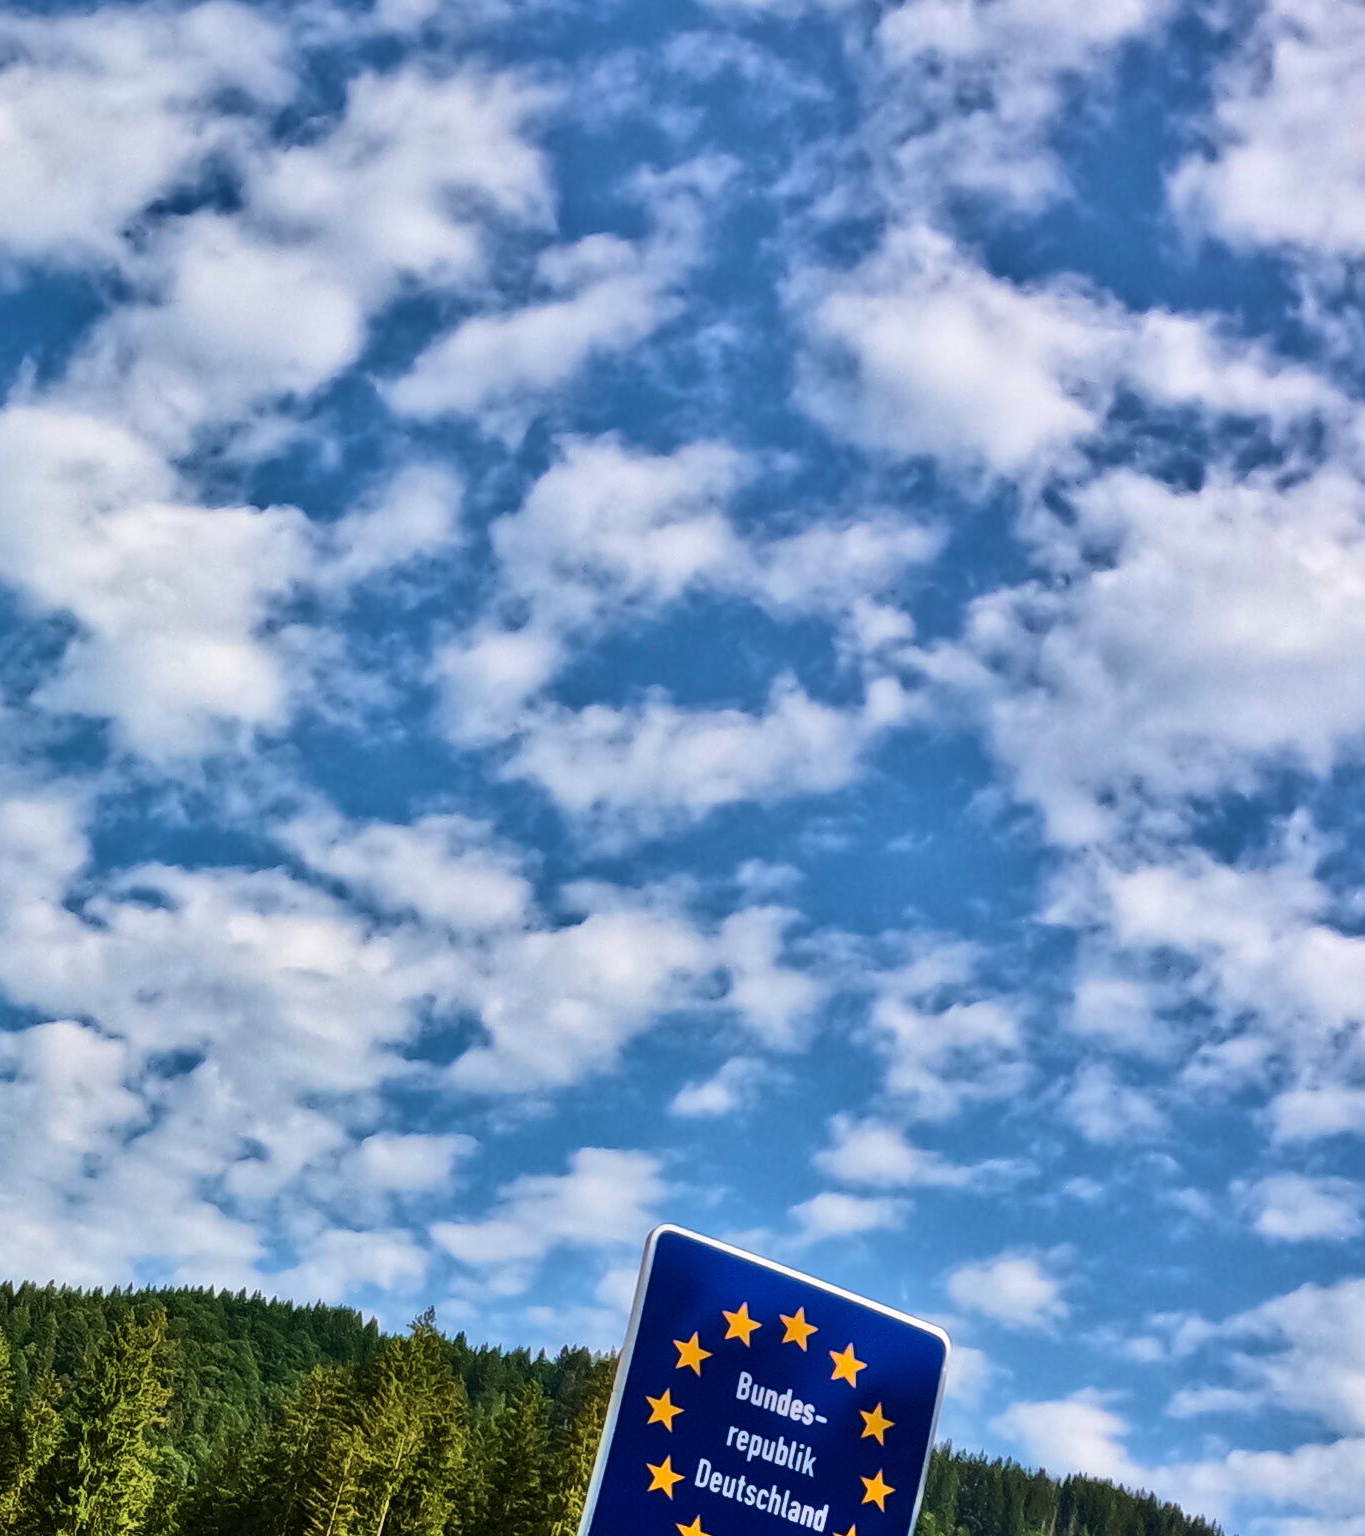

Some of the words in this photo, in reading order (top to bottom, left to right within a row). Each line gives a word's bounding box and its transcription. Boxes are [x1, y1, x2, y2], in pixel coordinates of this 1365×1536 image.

[735, 1371, 828, 1426] Bundes-
[726, 1425, 817, 1478] republik
[694, 1458, 830, 1533] Deutschland
